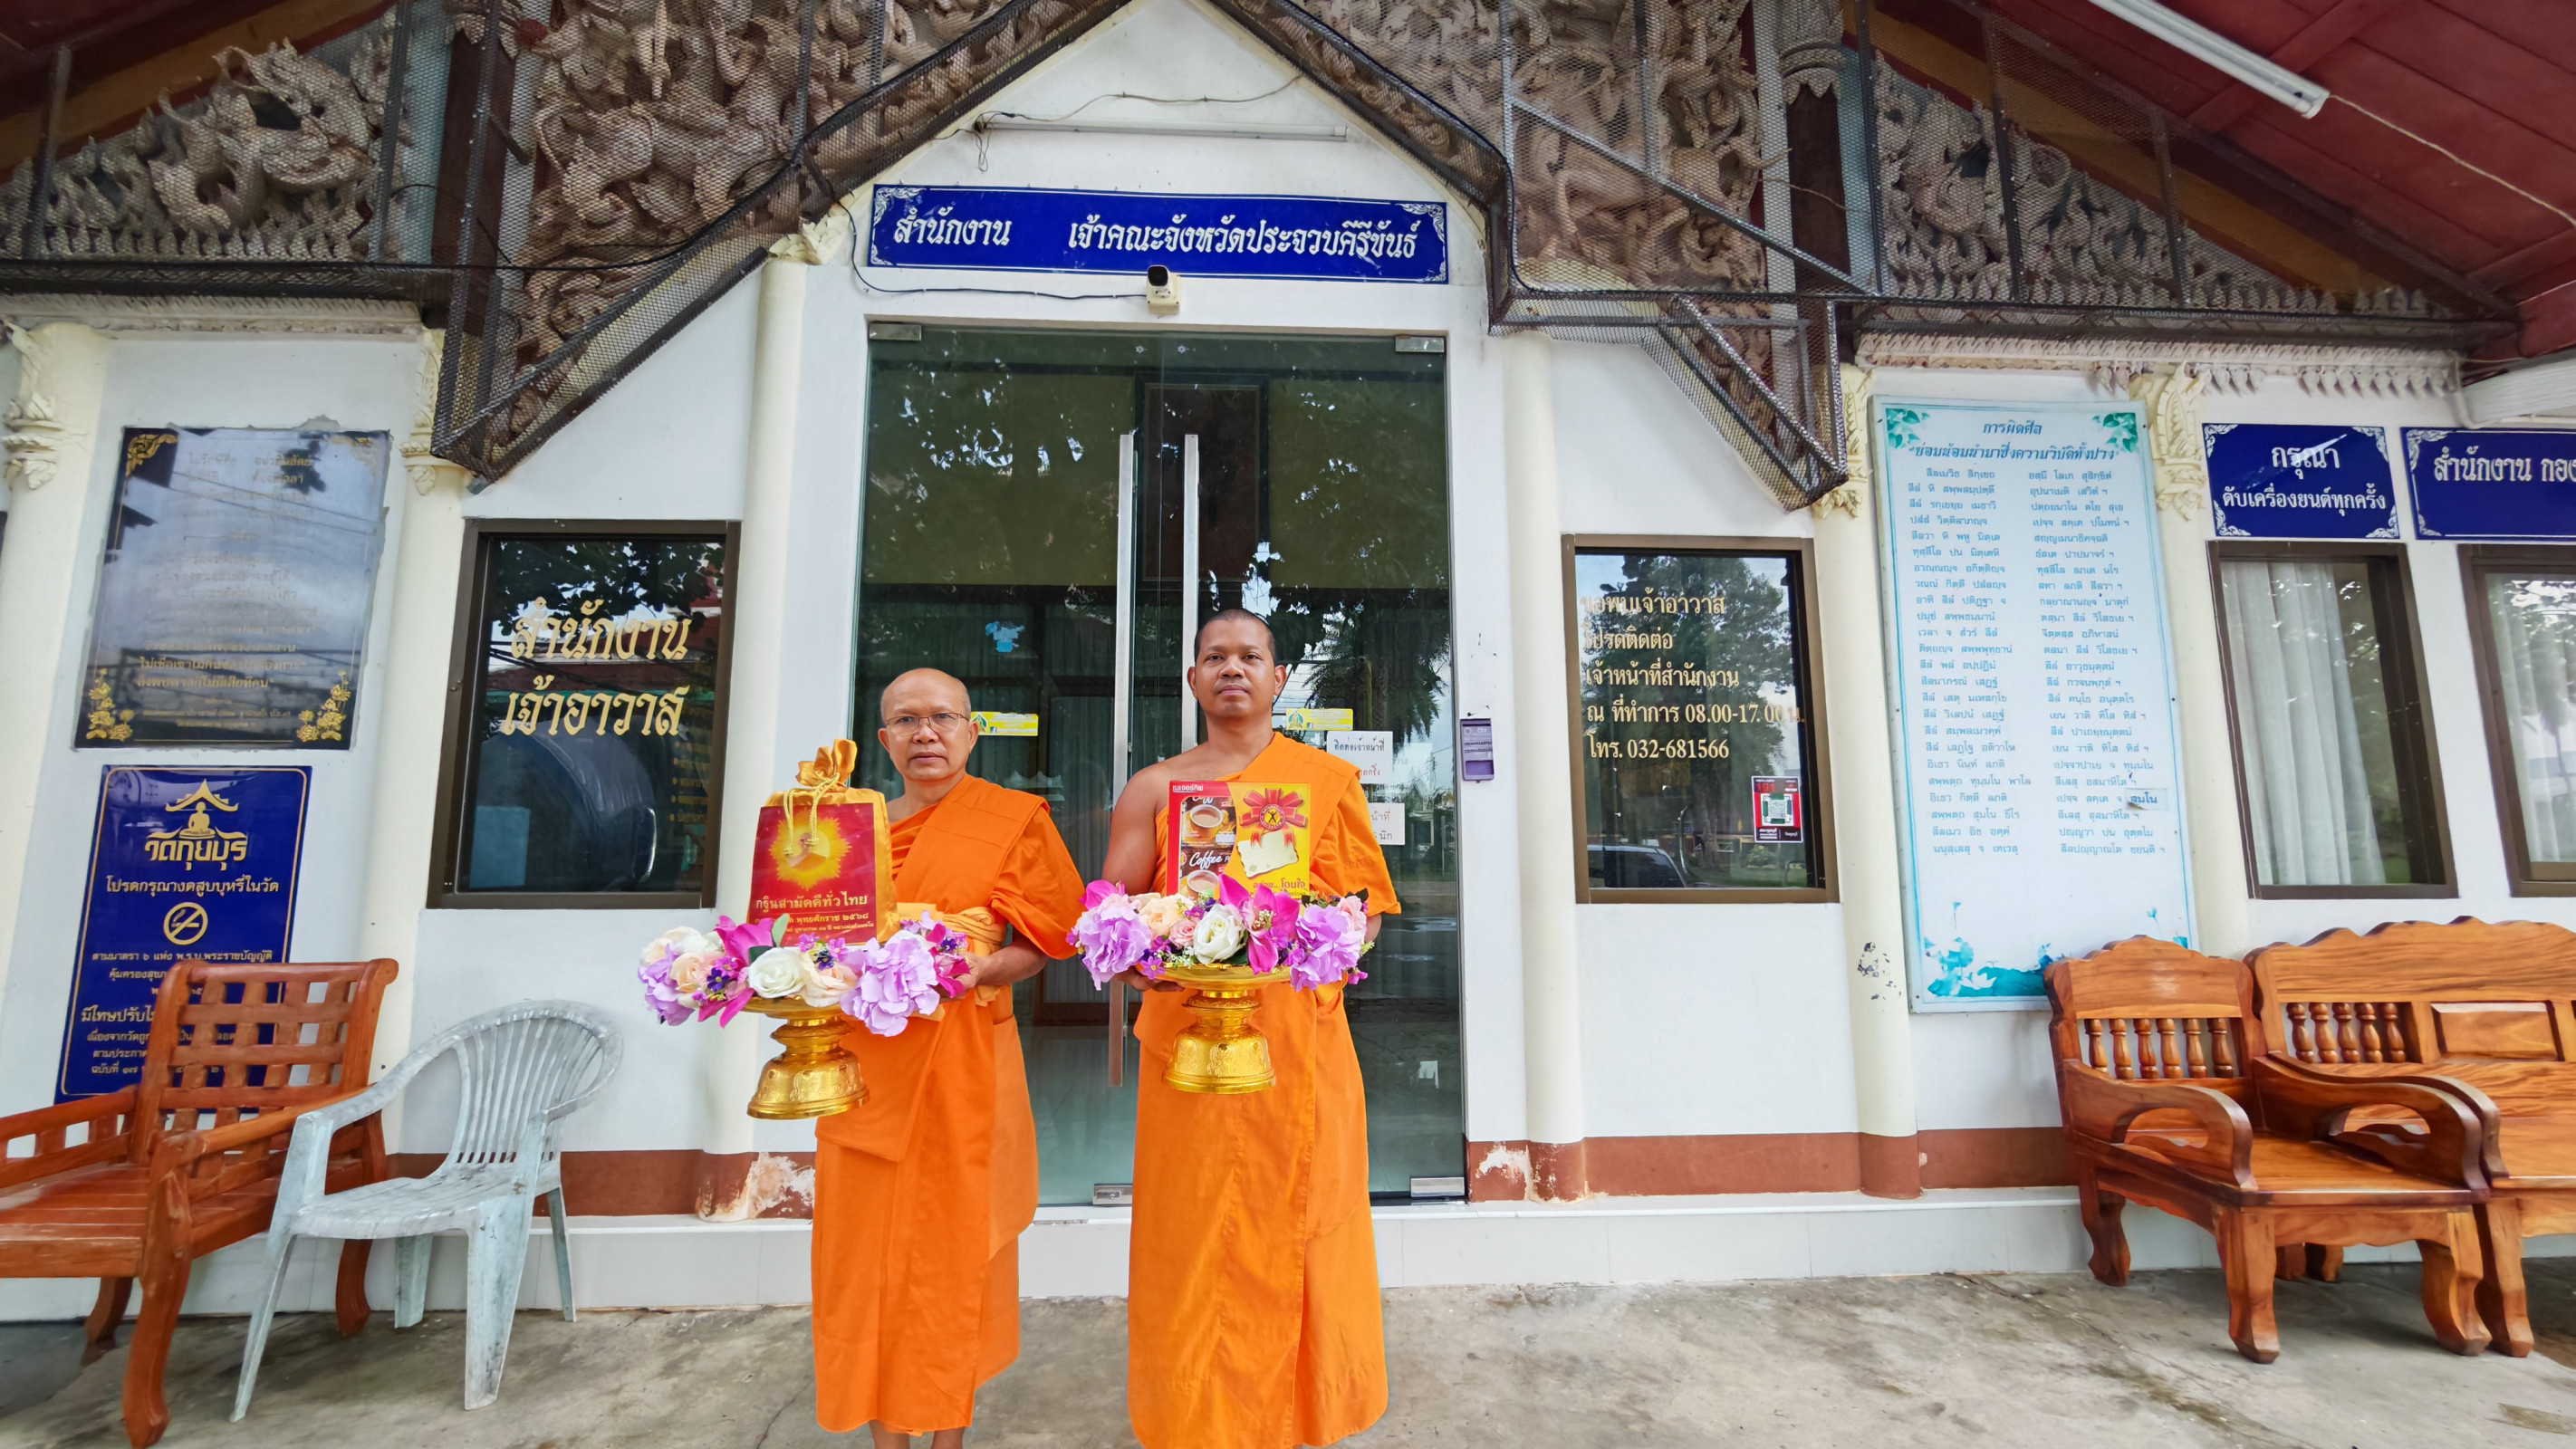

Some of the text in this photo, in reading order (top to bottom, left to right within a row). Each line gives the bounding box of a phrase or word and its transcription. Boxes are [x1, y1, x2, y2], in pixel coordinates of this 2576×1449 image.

[894, 206, 1421, 259] สำนักงาน เจ้าคณะจังหวัดประจวบคีรีขันธ์
[2272, 446, 2340, 480] กรุณา
[2434, 446, 2533, 482] สำนักงาน
[2222, 483, 2387, 517] ดับเครื่องยนต์ทุกครั้ง
[1580, 587, 1725, 615] ขอพบเจ้าอาวาส
[511, 597, 692, 660] สำนักงาน
[1581, 622, 1673, 649] โปรดติดต่อ
[1586, 657, 1739, 686] เจ้าหน้าที่สำนักงาน
[502, 675, 690, 736] เจ้าอาวาส
[1587, 705, 1604, 723] ณ
[1612, 694, 1678, 723] ที่ทำการ
[1587, 729, 1730, 759] โทร. 032-681566
[1189, 850, 1223, 869] Coffee
[106, 874, 279, 897] โปรดกรุณางดสูบบุหรี่ในวัด
